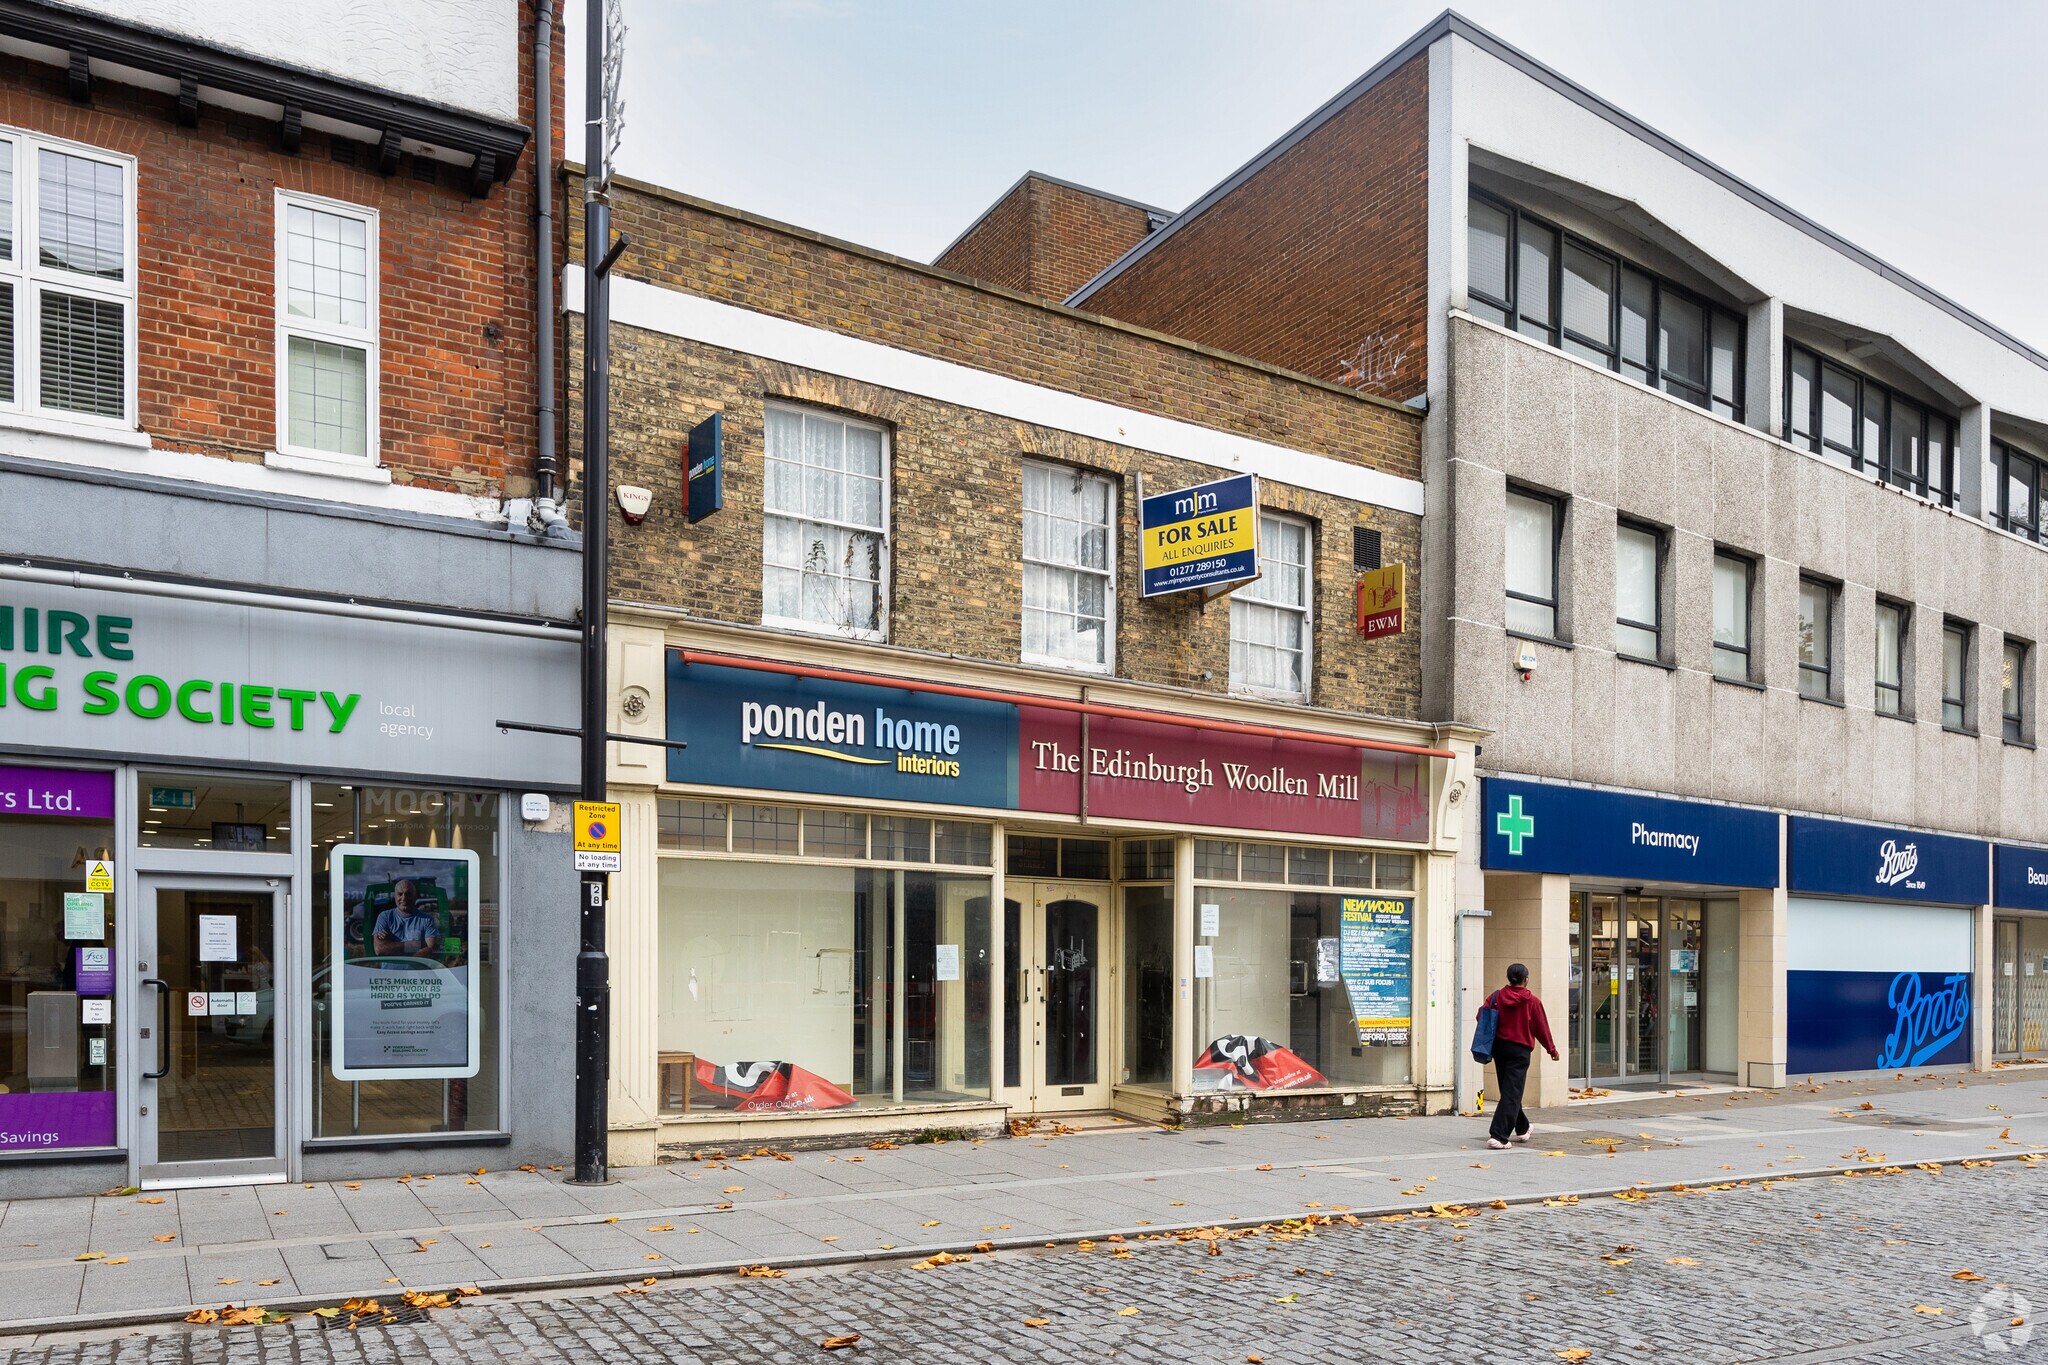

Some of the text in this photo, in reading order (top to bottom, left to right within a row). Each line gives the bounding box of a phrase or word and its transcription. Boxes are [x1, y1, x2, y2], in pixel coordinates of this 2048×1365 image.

[623, 492, 649, 502] KINGS
[1158, 515, 1238, 547] FOR SALE
[1162, 538, 1235, 562] ALL ENQUIRIES
[1153, 564, 1246, 588] www.mjmpropertyconsultants.co.uk
[1169, 558, 1227, 577] 01277 289150
[1367, 614, 1398, 633] EWM
[82, 670, 361, 733] SOCIETY
[379, 701, 416, 718] local
[379, 722, 434, 740] agency
[741, 700, 960, 755] ponden home
[897, 751, 960, 778] interiors
[1032, 740, 1359, 801] The Edinburgh Woollen Mill
[28, 788, 81, 812] Ltd.
[579, 804, 616, 813] Restricted
[588, 812, 606, 820] Zone
[1631, 822, 1700, 856] Pharmacy
[591, 854, 617, 862] loading
[1875, 839, 1918, 887] Boots
[1905, 879, 1917, 889] Since
[2027, 866, 2048, 886] Beau
[1343, 911, 1373, 923] FESTIVAL
[420, 978, 443, 986] YOUR
[1877, 971, 1970, 1071] Boots
[1388, 1033, 1408, 1041] ESSEX
[747, 1101, 773, 1109] Order
[0, 1131, 59, 1145] Savings
